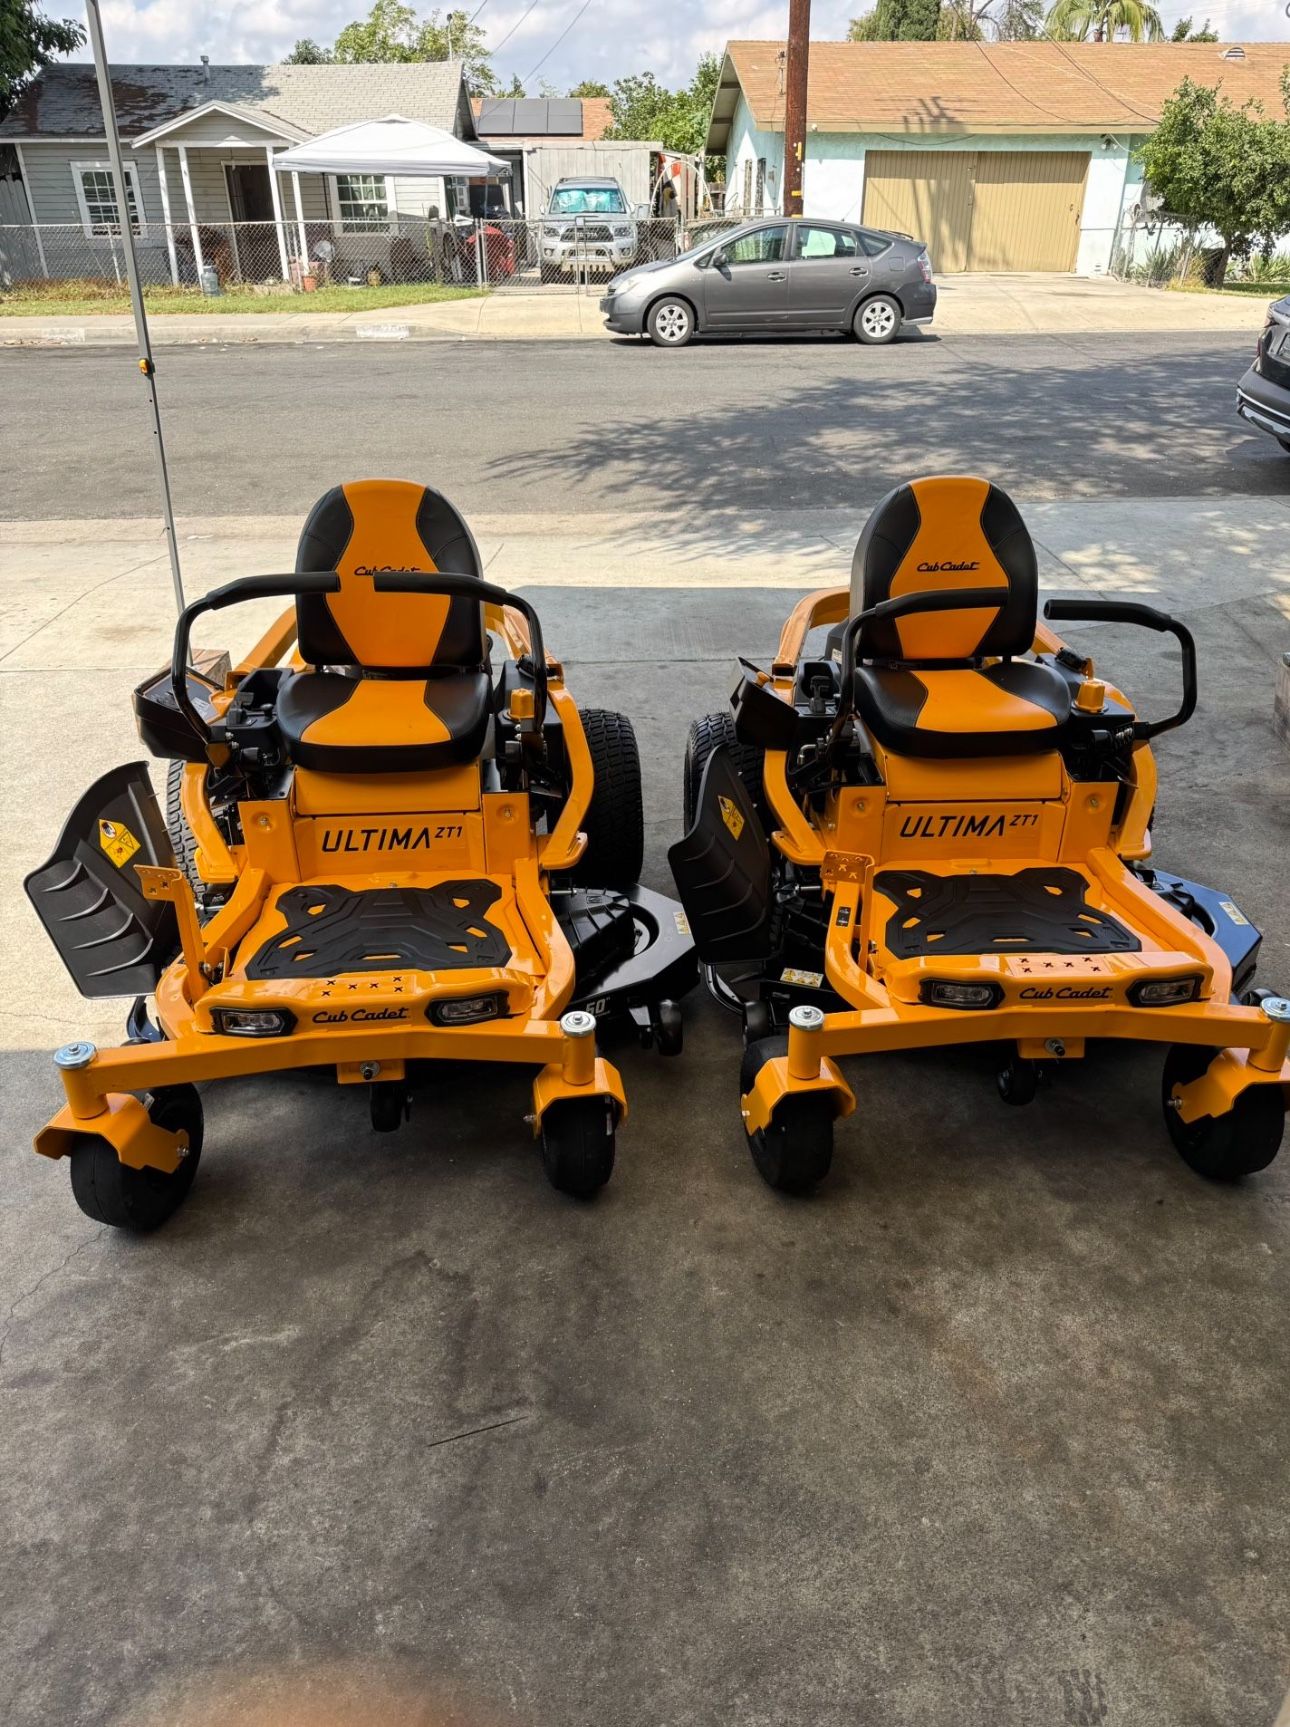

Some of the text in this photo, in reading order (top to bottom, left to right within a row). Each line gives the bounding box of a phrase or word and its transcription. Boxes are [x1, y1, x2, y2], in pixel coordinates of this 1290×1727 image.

[917, 561, 980, 572] Cub Cadet
[900, 814, 1038, 838] ULTIMA ZT1
[322, 826, 462, 852] ULTIMA ZT1
[1020, 986, 1113, 999] Cub Cadet
[312, 1007, 409, 1023] Cub Cadet
